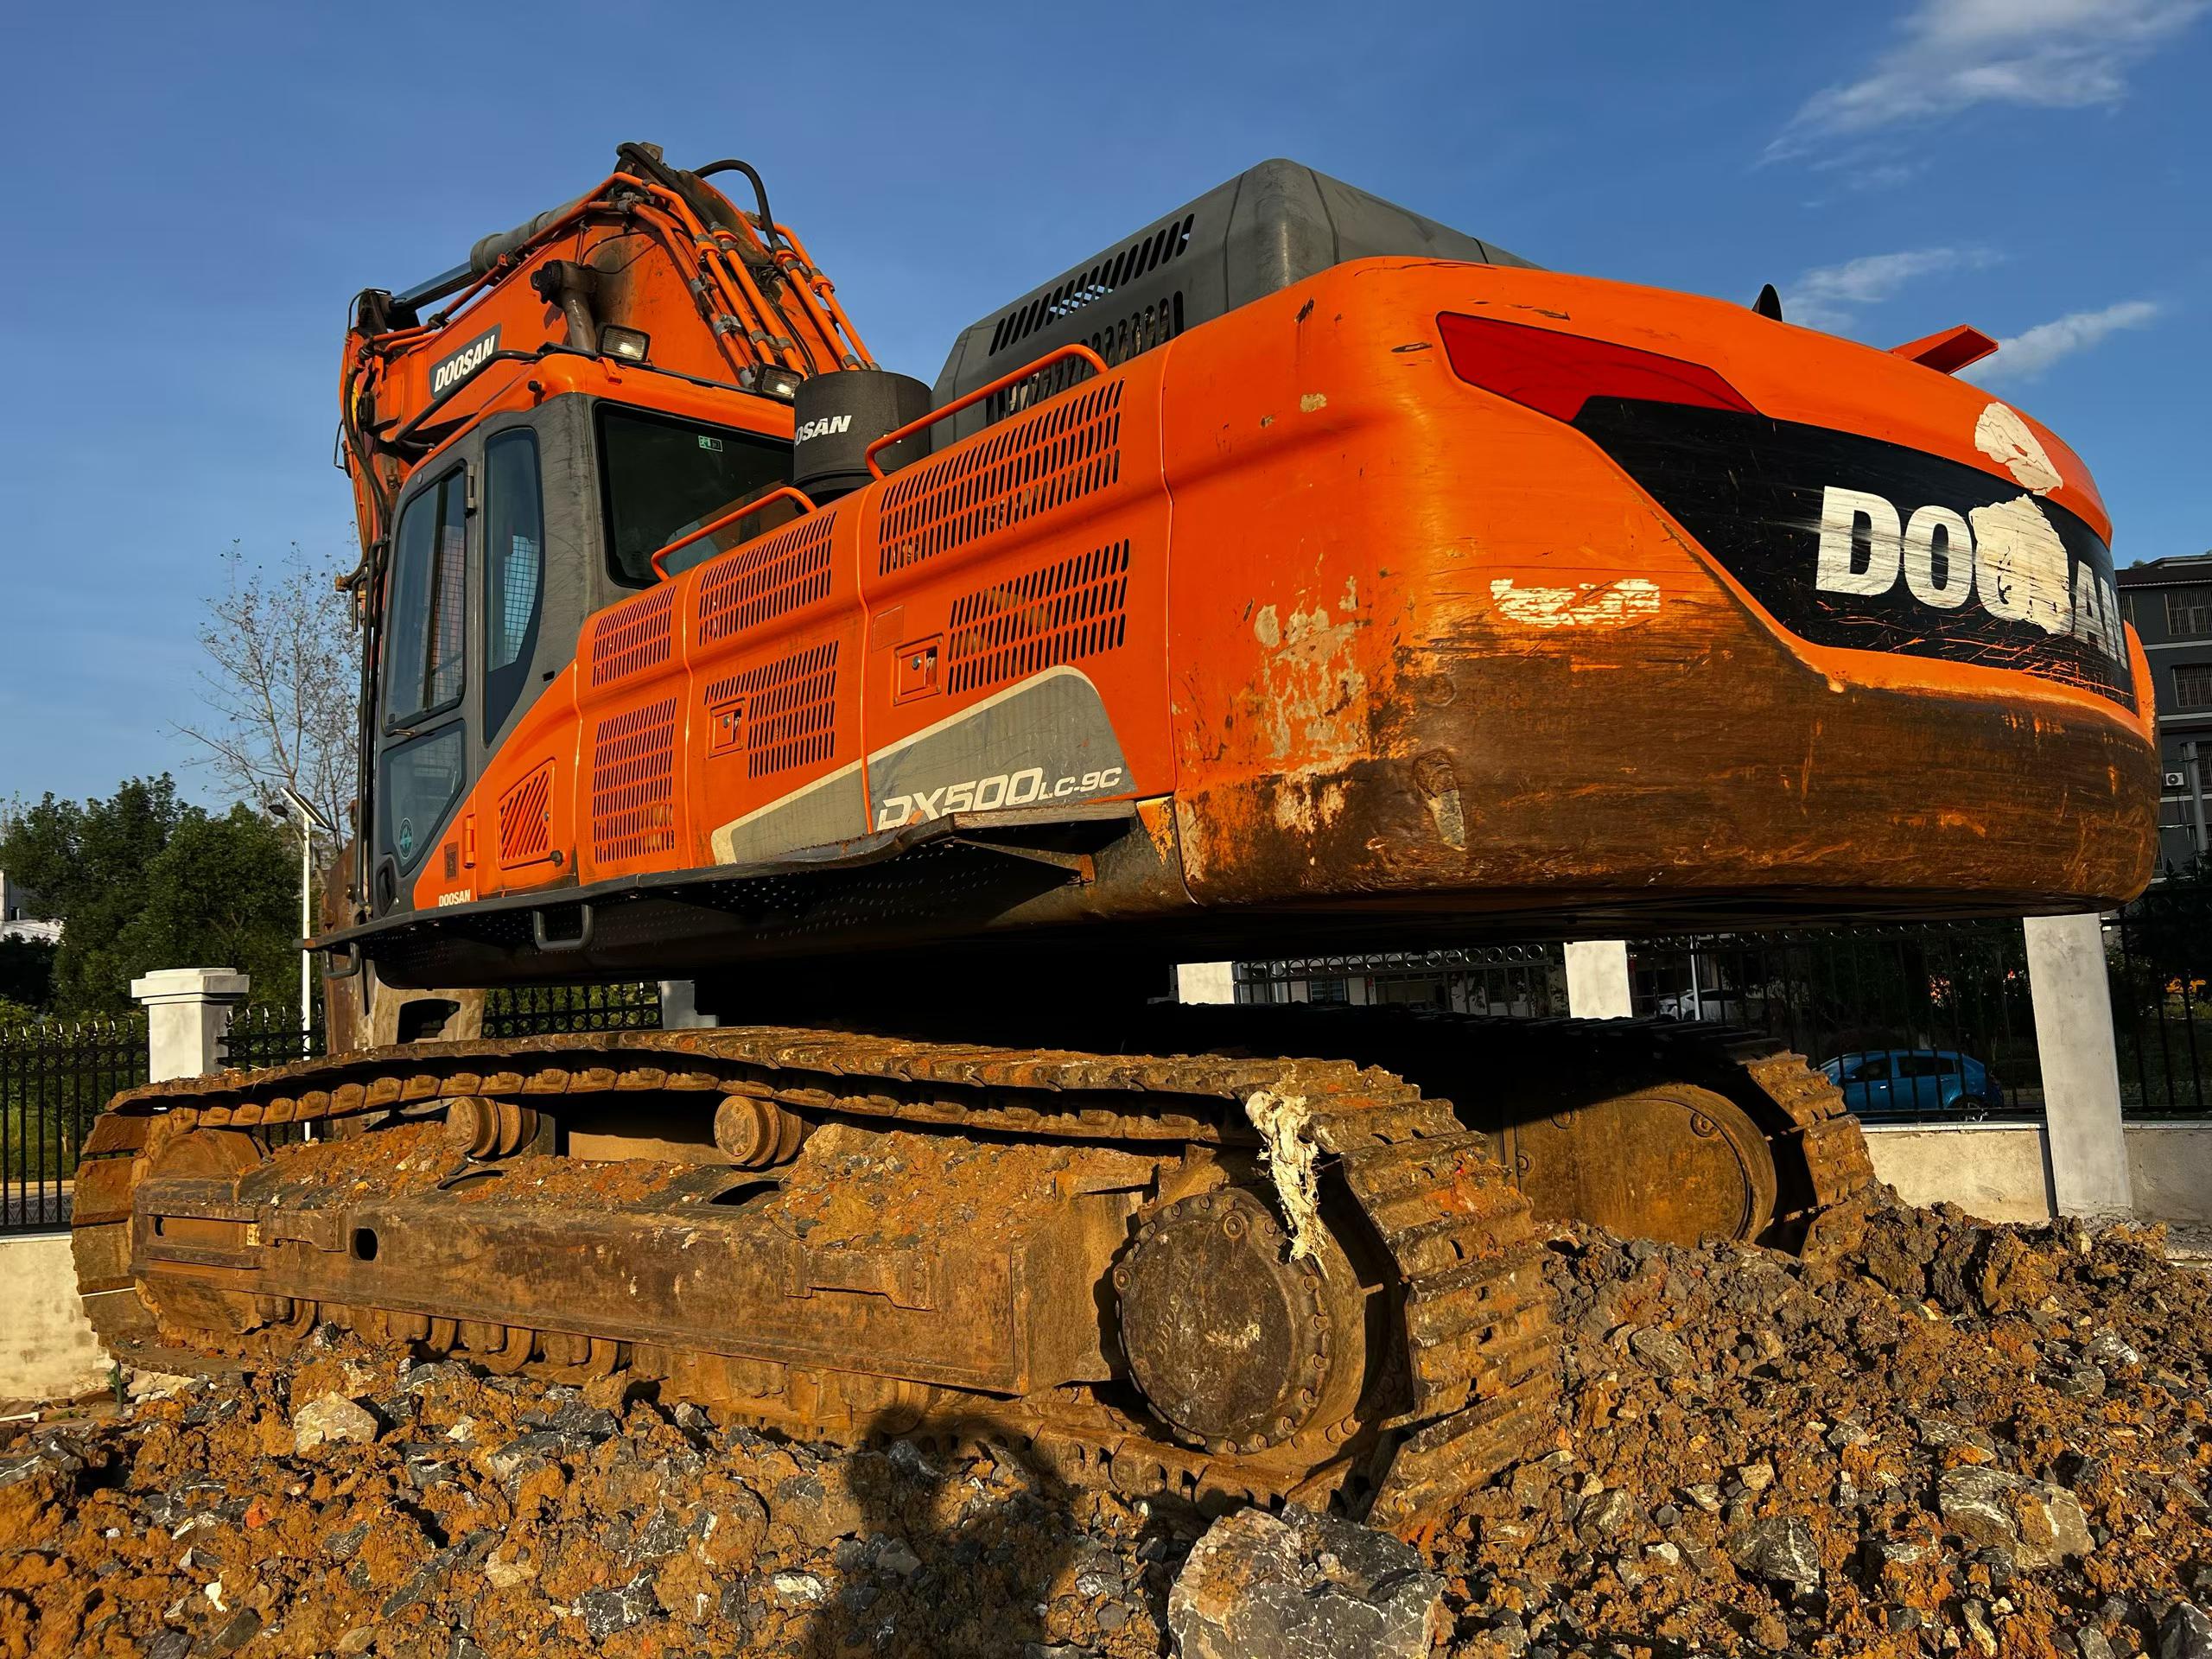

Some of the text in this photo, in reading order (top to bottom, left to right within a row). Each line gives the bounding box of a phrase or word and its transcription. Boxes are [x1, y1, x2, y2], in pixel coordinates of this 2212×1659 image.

[434, 334, 496, 393] DOOSAN
[1815, 486, 2128, 671] DOAN
[438, 888, 471, 907] DOOSAN
